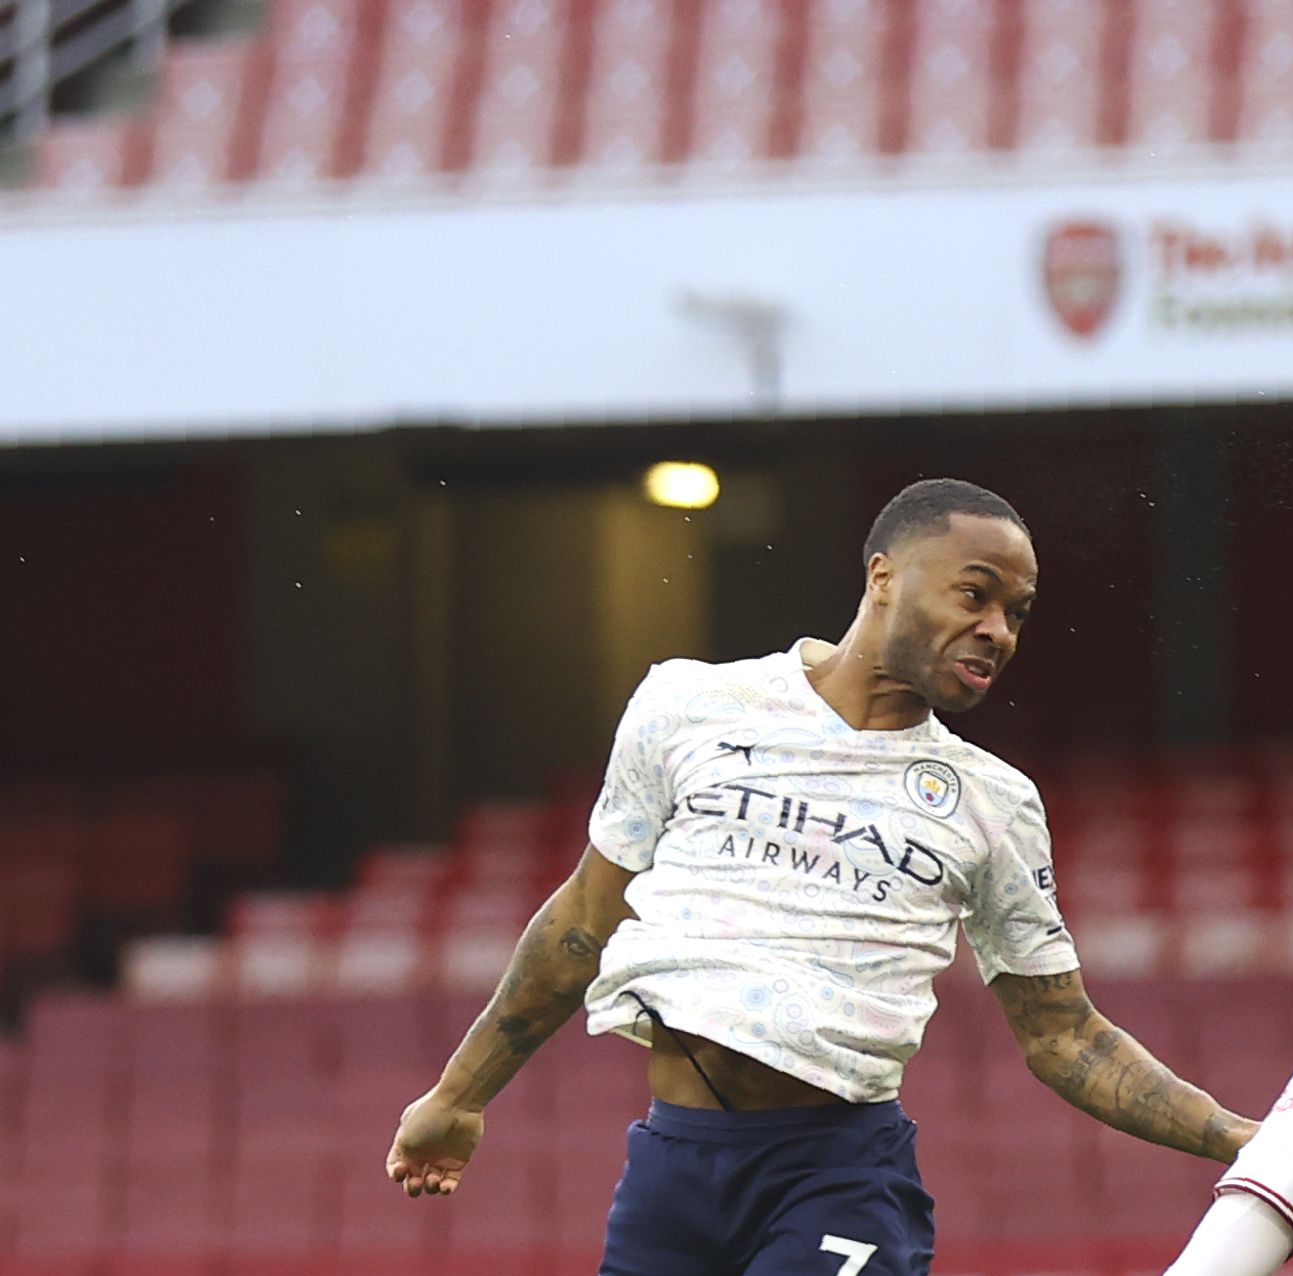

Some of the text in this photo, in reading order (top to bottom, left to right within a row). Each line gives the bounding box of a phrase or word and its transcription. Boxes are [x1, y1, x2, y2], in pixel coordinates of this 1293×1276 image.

[1150, 216, 1230, 276] The
[686, 783, 944, 887] ETIHAD
[717, 834, 892, 901] AIRWAYS
